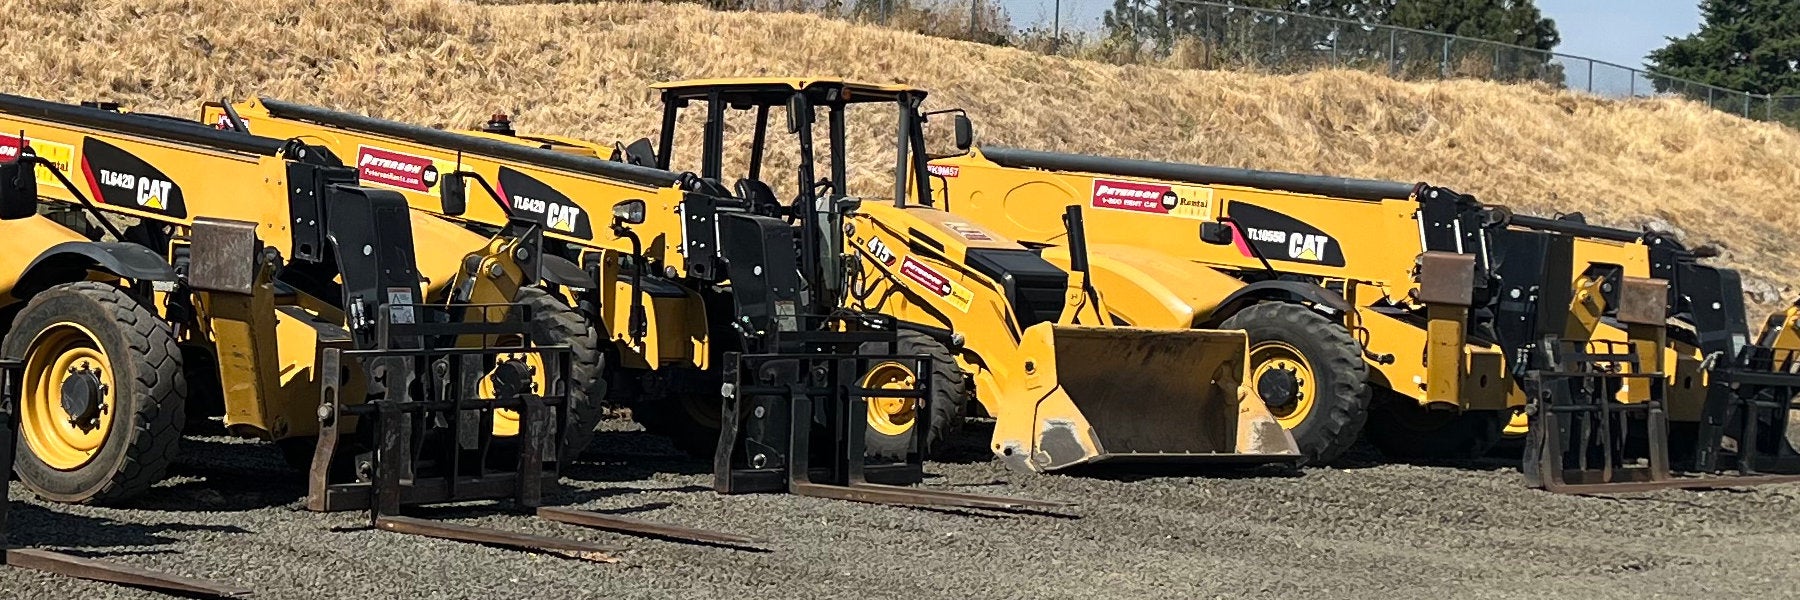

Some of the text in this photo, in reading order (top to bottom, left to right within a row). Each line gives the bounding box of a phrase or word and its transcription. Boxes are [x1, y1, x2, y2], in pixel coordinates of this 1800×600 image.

[136, 176, 172, 211] CAT
[1179, 197, 1209, 208] Rental
[546, 202, 580, 233] CAT
[1288, 232, 1329, 262] CAT
